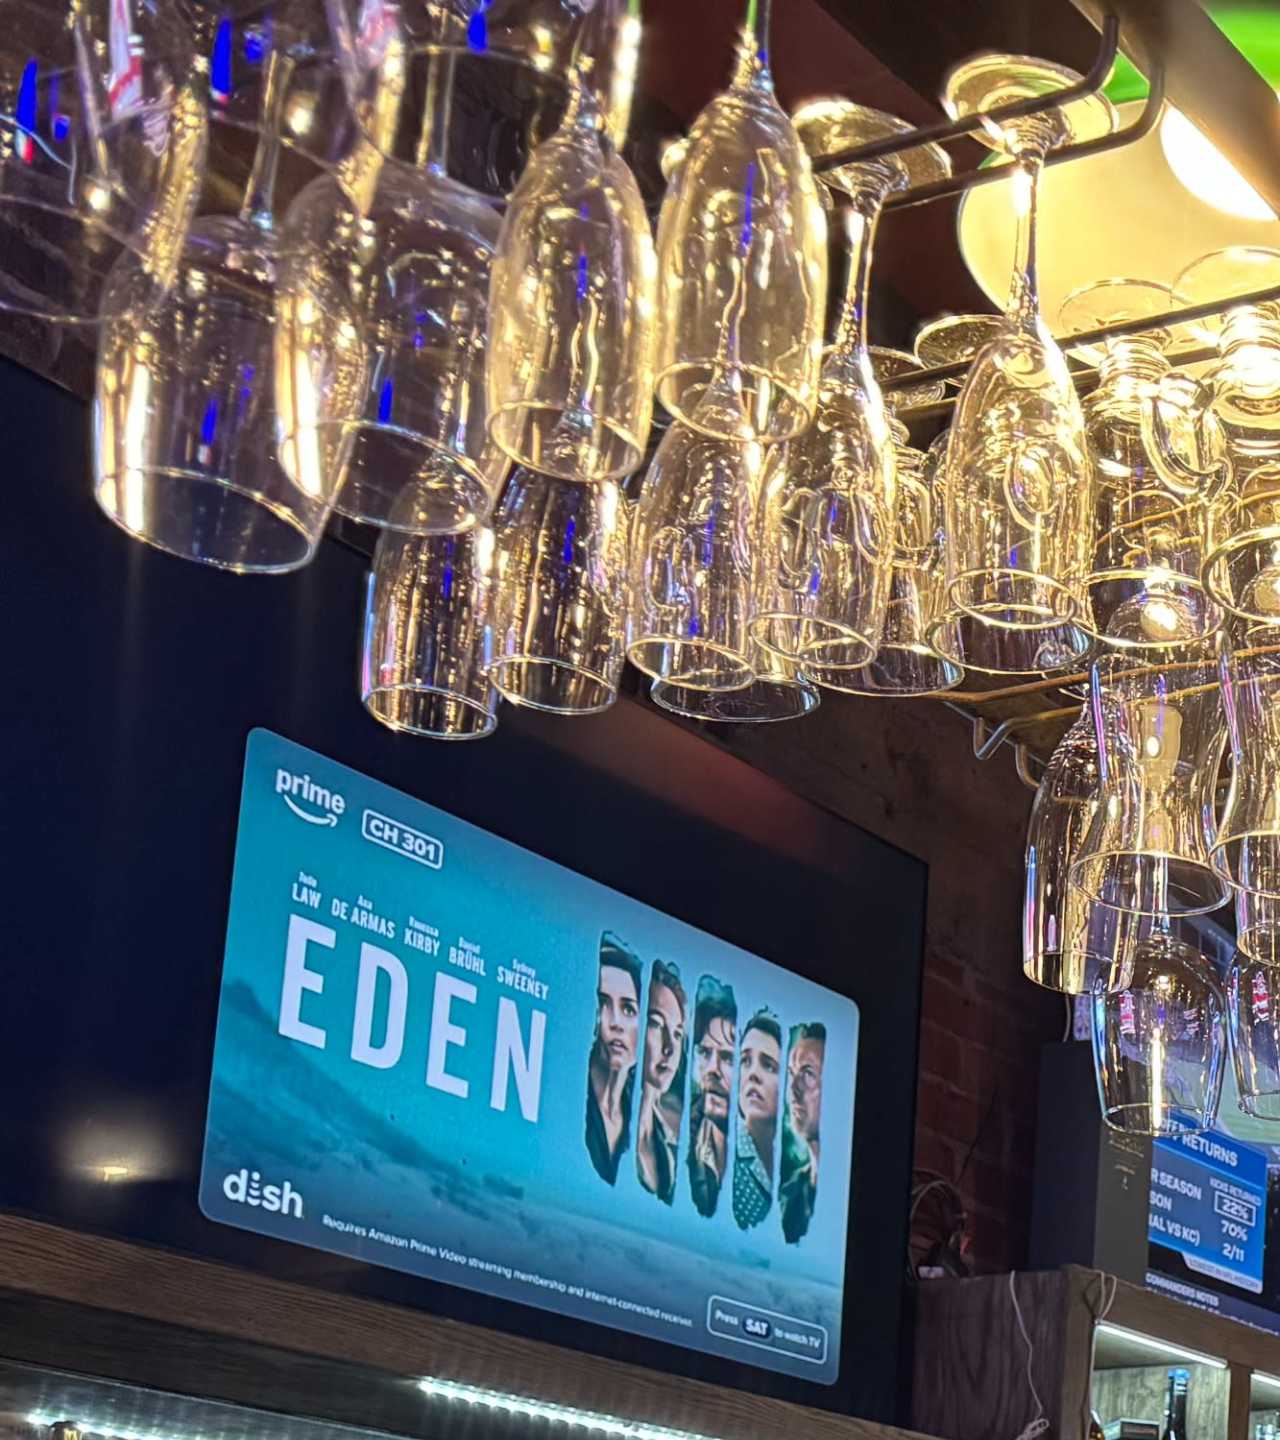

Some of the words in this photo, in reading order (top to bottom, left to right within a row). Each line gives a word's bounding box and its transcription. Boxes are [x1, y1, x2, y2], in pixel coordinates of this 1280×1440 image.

[275, 768, 346, 815] prime
[369, 818, 398, 844] CH
[402, 832, 436, 861] 301
[292, 882, 322, 909] LAW
[331, 898, 349, 921] DE
[350, 906, 397, 939] ARMAS
[403, 928, 441, 958] KIRBY
[448, 947, 487, 977] BRÜHL
[496, 965, 549, 1001] SWEENEY
[276, 911, 548, 1125] EDEN
[1181, 1131, 1239, 1168] RETURNS
[222, 1168, 304, 1219] dish
[1222, 1199, 1249, 1220] 22%
[368, 1227, 409, 1249] Amazon
[410, 1238, 437, 1256] Prime
[438, 1246, 467, 1266] Video
[1221, 1219, 1248, 1241] 70%
[745, 1319, 768, 1336] SAT
